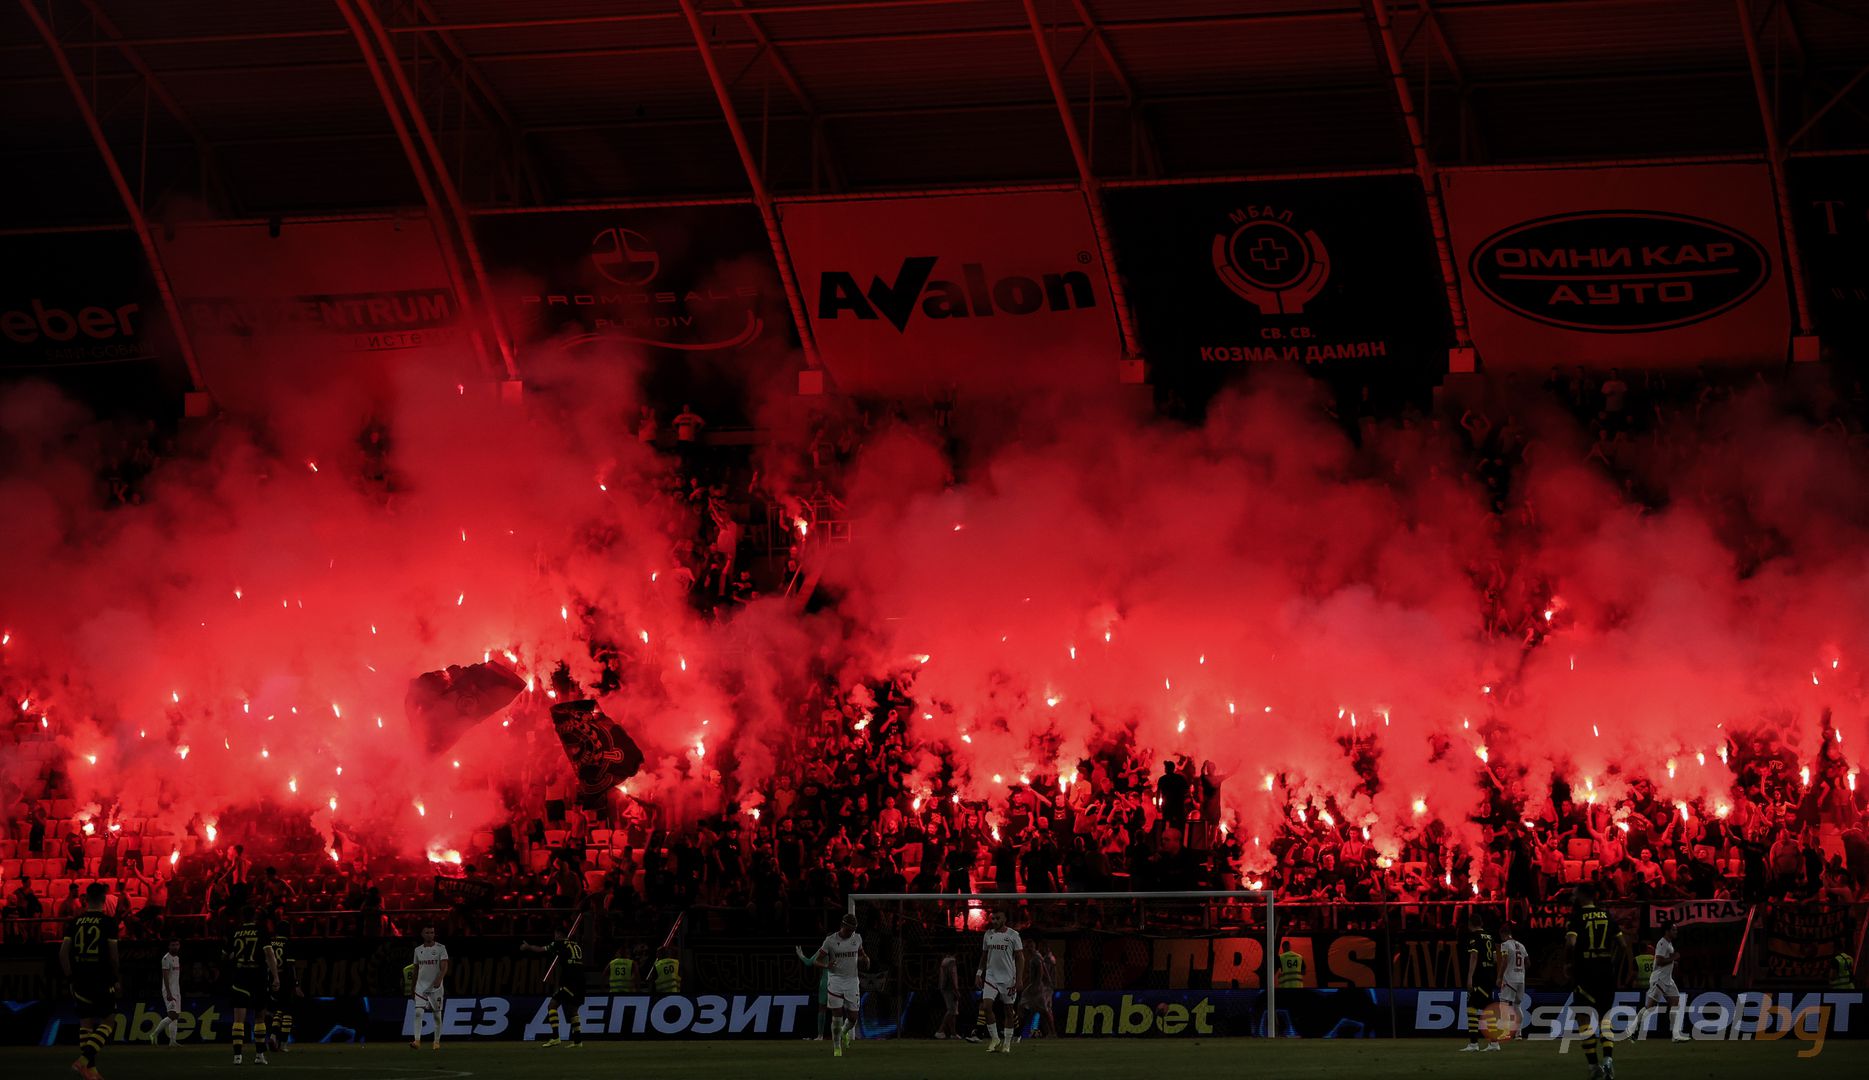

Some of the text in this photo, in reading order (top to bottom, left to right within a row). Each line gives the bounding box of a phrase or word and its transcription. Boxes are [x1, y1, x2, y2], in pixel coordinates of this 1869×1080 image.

[1228, 204, 1296, 225] МБАЛ
[1494, 241, 1736, 270] ОМНИ КАР
[1547, 280, 1695, 305] АУТО
[1200, 340, 1387, 364] КОЗМА И ДАМЯН
[1656, 902, 1747, 924] BULTRAS
[74, 925, 101, 954] 42
[1585, 919, 1609, 950] 17
[234, 937, 258, 962] 27
[566, 943, 582, 960] 10
[1515, 951, 1522, 967] 6
[1286, 959, 1298, 968] 64
[523, 995, 810, 1041] ДЕПОЗИТ
[1065, 992, 1216, 1036] inbet
